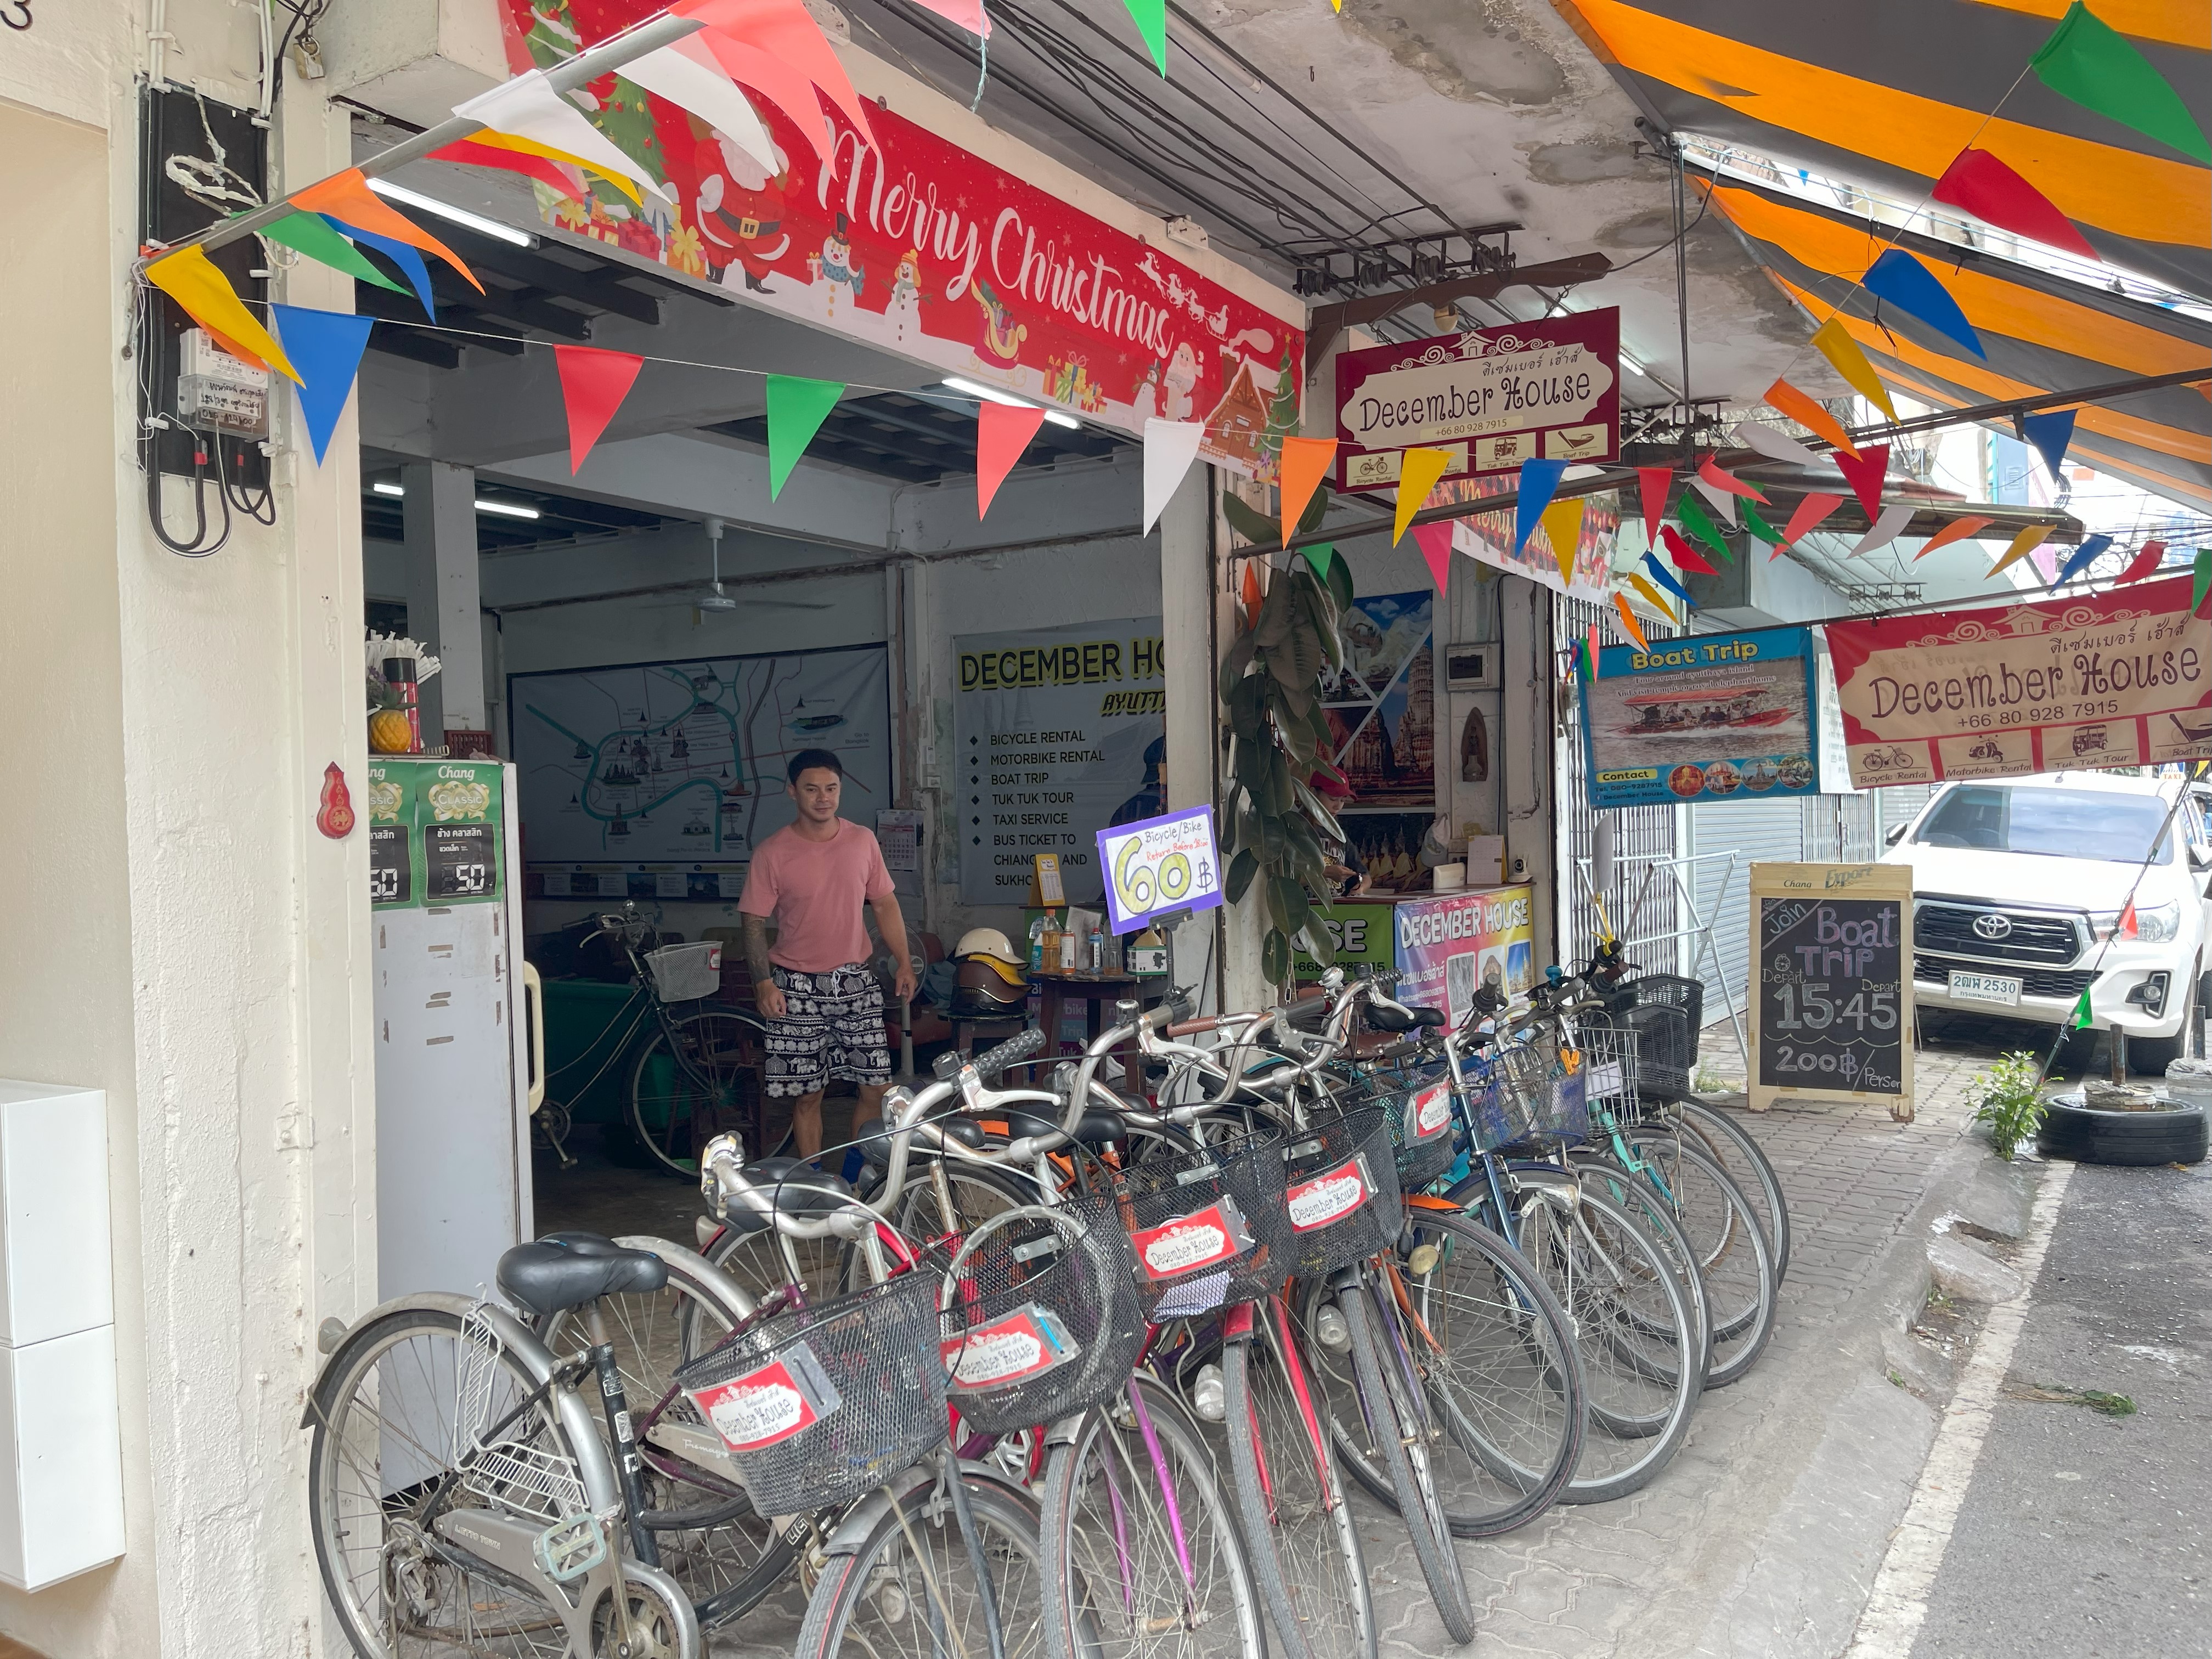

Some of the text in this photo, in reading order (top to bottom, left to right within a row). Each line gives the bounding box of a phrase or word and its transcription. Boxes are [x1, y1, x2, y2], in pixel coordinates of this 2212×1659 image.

[817, 116, 1175, 359] Merry Christmas
[1482, 352, 1544, 377] ดีเซมเบอร์
[1360, 373, 1590, 432] December House
[1435, 419, 1507, 436] +66 80 928 7915
[1375, 475, 1392, 483] Rental
[2050, 611, 2191, 653] ดีเซมเบอร์ เฮ้าส์
[1632, 640, 1758, 670] Boat Trip
[961, 643, 1121, 687] DECEMBER
[1870, 647, 2201, 718] December House
[1957, 700, 2118, 728] +66 80 928 7915
[990, 731, 1086, 746] BICYCLE RENTAL
[991, 750, 1105, 765] MOTORBIKE RENTAL
[2172, 746, 2193, 757] Boat
[2055, 753, 2129, 769] Tuk Tuk Tour
[438, 765, 475, 780] Chang
[991, 772, 1049, 785] BOAT TRIP
[1603, 770, 1649, 781] Contact
[1860, 770, 1927, 785] Bicycle Rental
[1946, 763, 2032, 777] Motorbike Rental
[370, 796, 394, 805] SSIC
[992, 792, 1074, 805] TUK TUK TOUR
[993, 812, 1068, 825] TAXI SERVICE
[994, 834, 1076, 846] BUS TICKET TO
[1062, 854, 1087, 865] AND
[1147, 849, 1171, 862] Return
[1173, 840, 1193, 853] Before
[456, 864, 485, 891] 50
[1115, 836, 1192, 915] 60
[1825, 866, 1874, 889] Export
[1400, 898, 1530, 950] DECEMBER HOUSE
[1764, 902, 1807, 935] Join
[1814, 906, 1898, 949] Boat
[1762, 968, 1807, 985] Depart
[1861, 978, 1901, 994] Depart
[1984, 979, 2016, 994] 2530
[1773, 983, 1898, 1031] 15:45
[1062, 1025, 1083, 1039] Trip
[1292, 1185, 1357, 1221] December House
[1151, 1235, 1219, 1266] December House
[716, 1398, 793, 1435] December House
